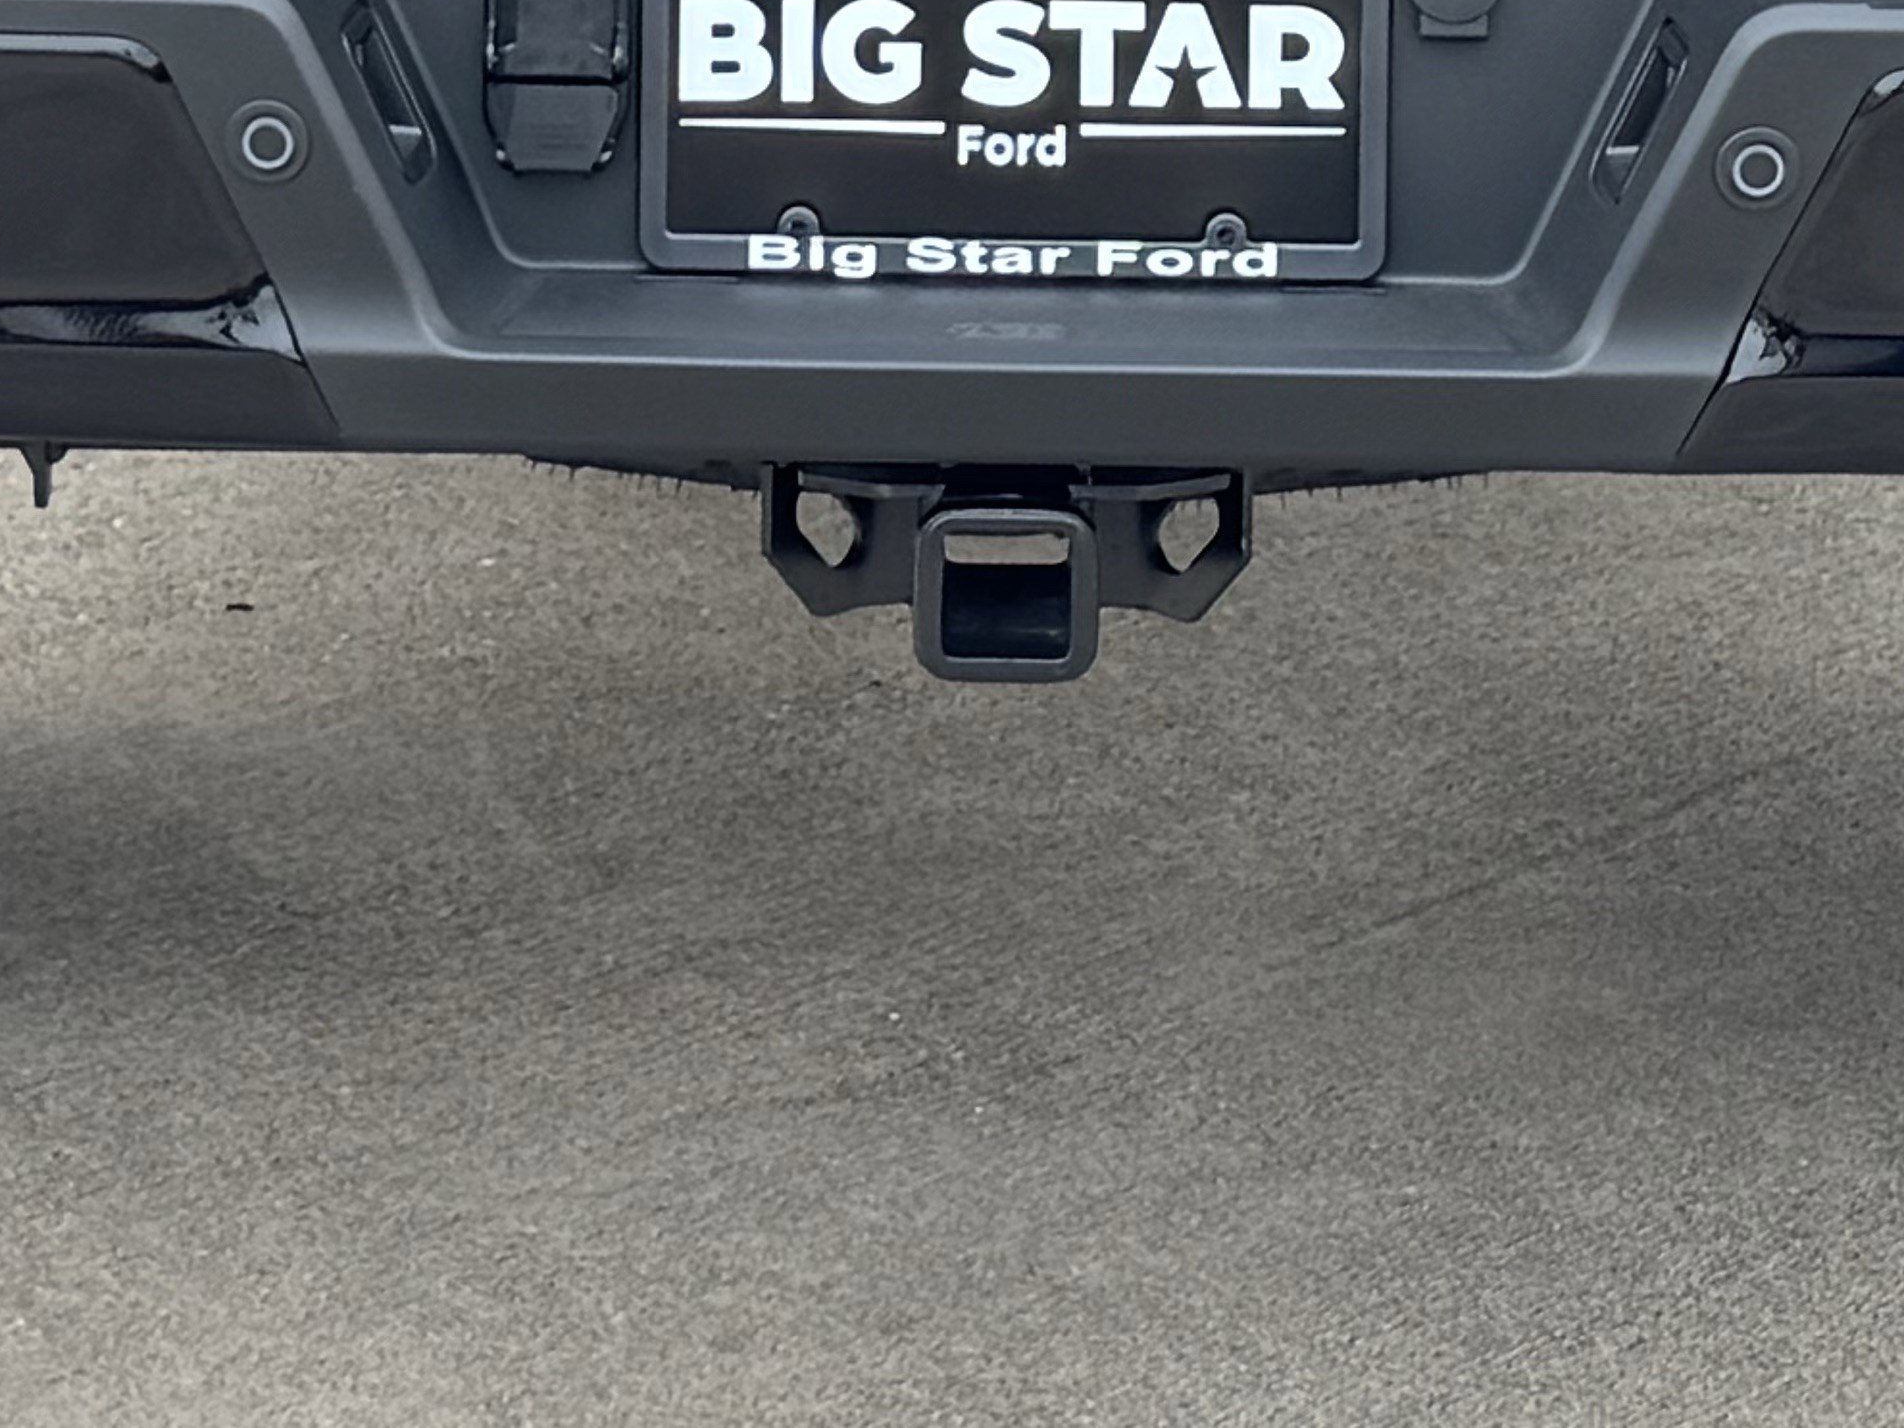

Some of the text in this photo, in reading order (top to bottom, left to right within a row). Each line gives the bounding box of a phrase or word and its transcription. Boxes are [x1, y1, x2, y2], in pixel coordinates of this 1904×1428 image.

[957, 124, 1067, 167] Ford
[747, 234, 1279, 279] Big Star Ford
